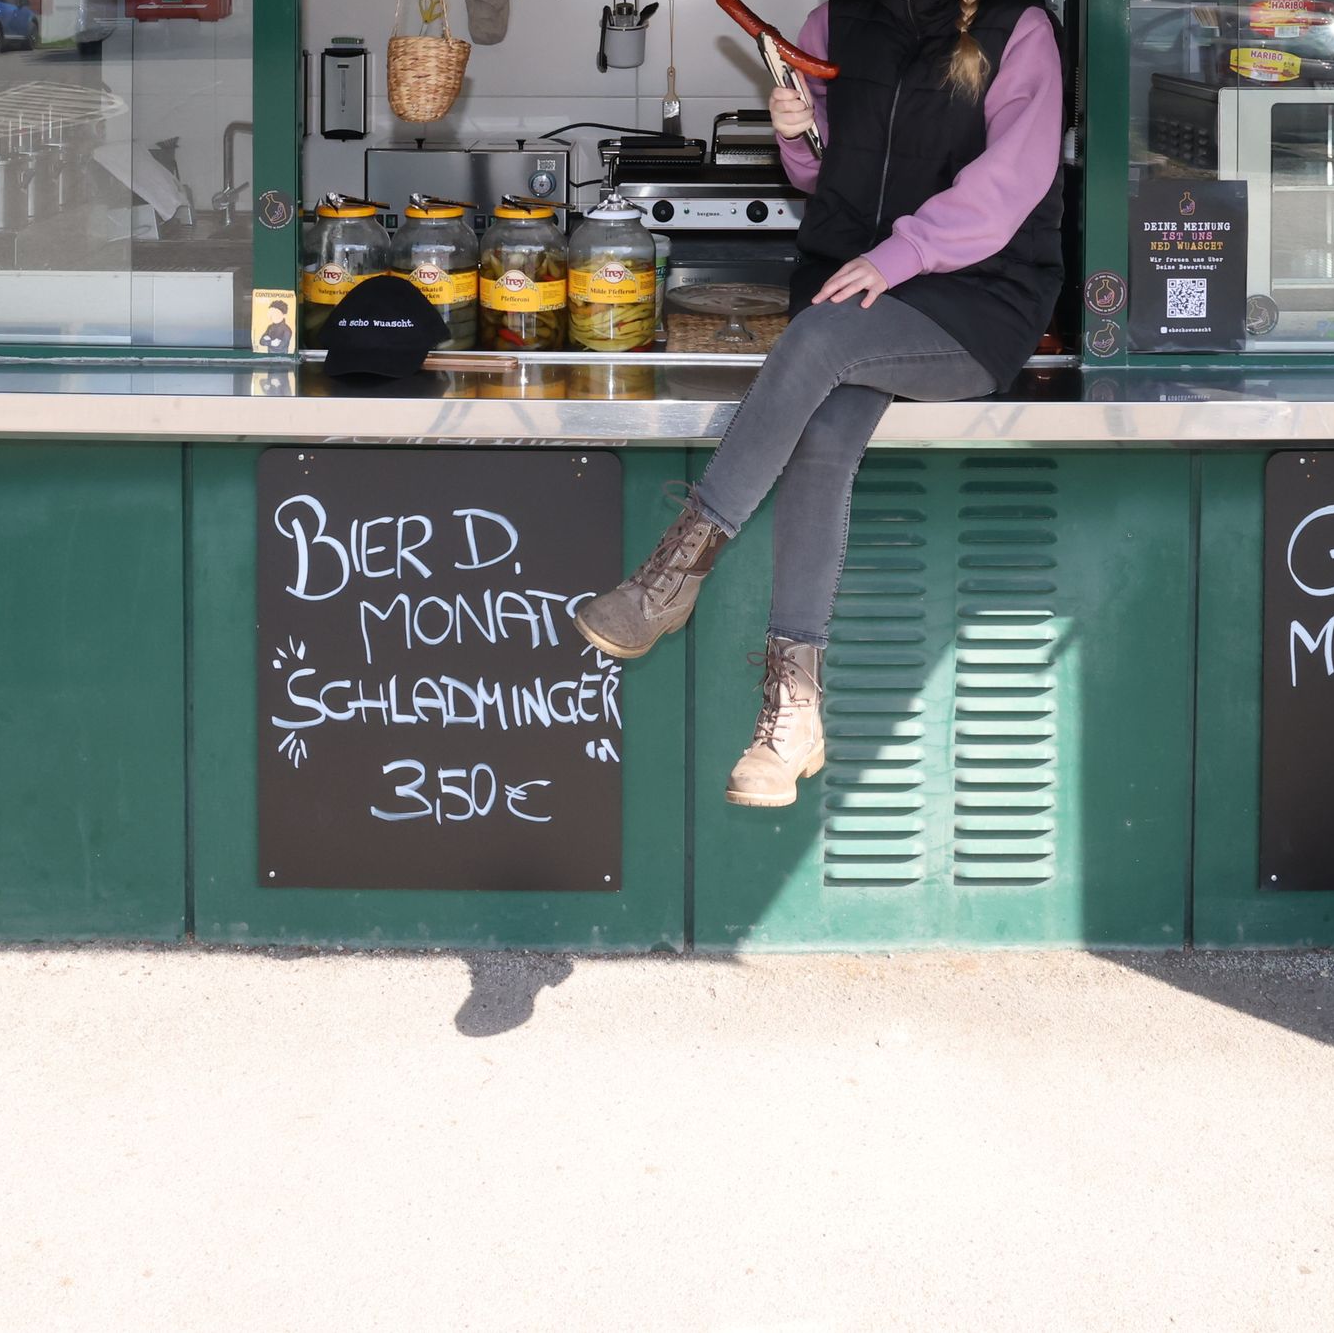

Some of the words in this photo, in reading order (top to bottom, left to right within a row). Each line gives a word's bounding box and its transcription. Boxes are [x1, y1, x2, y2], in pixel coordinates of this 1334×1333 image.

[1271, 0, 1306, 11] HARIBO
[1250, 50, 1284, 61] HARIBO
[1143, 222, 1178, 231] DEINE
[1183, 222, 1231, 231] MEINUNG
[1161, 231, 1184, 241] IST
[1191, 231, 1213, 241] UNS
[1150, 241, 1171, 251] NED
[1176, 241, 1224, 251] WUASCHT
[323, 269, 342, 282] frey
[417, 269, 438, 282] frey
[604, 267, 624, 279] frey
[505, 275, 525, 287] frey
[500, 295, 530, 303] Pfefferoni
[349, 318, 369, 327] scho
[373, 319, 414, 327] wuascht.
[274, 493, 433, 601] BIER
[453, 508, 522, 575] D.
[271, 667, 623, 730] SCHLADMINGER
